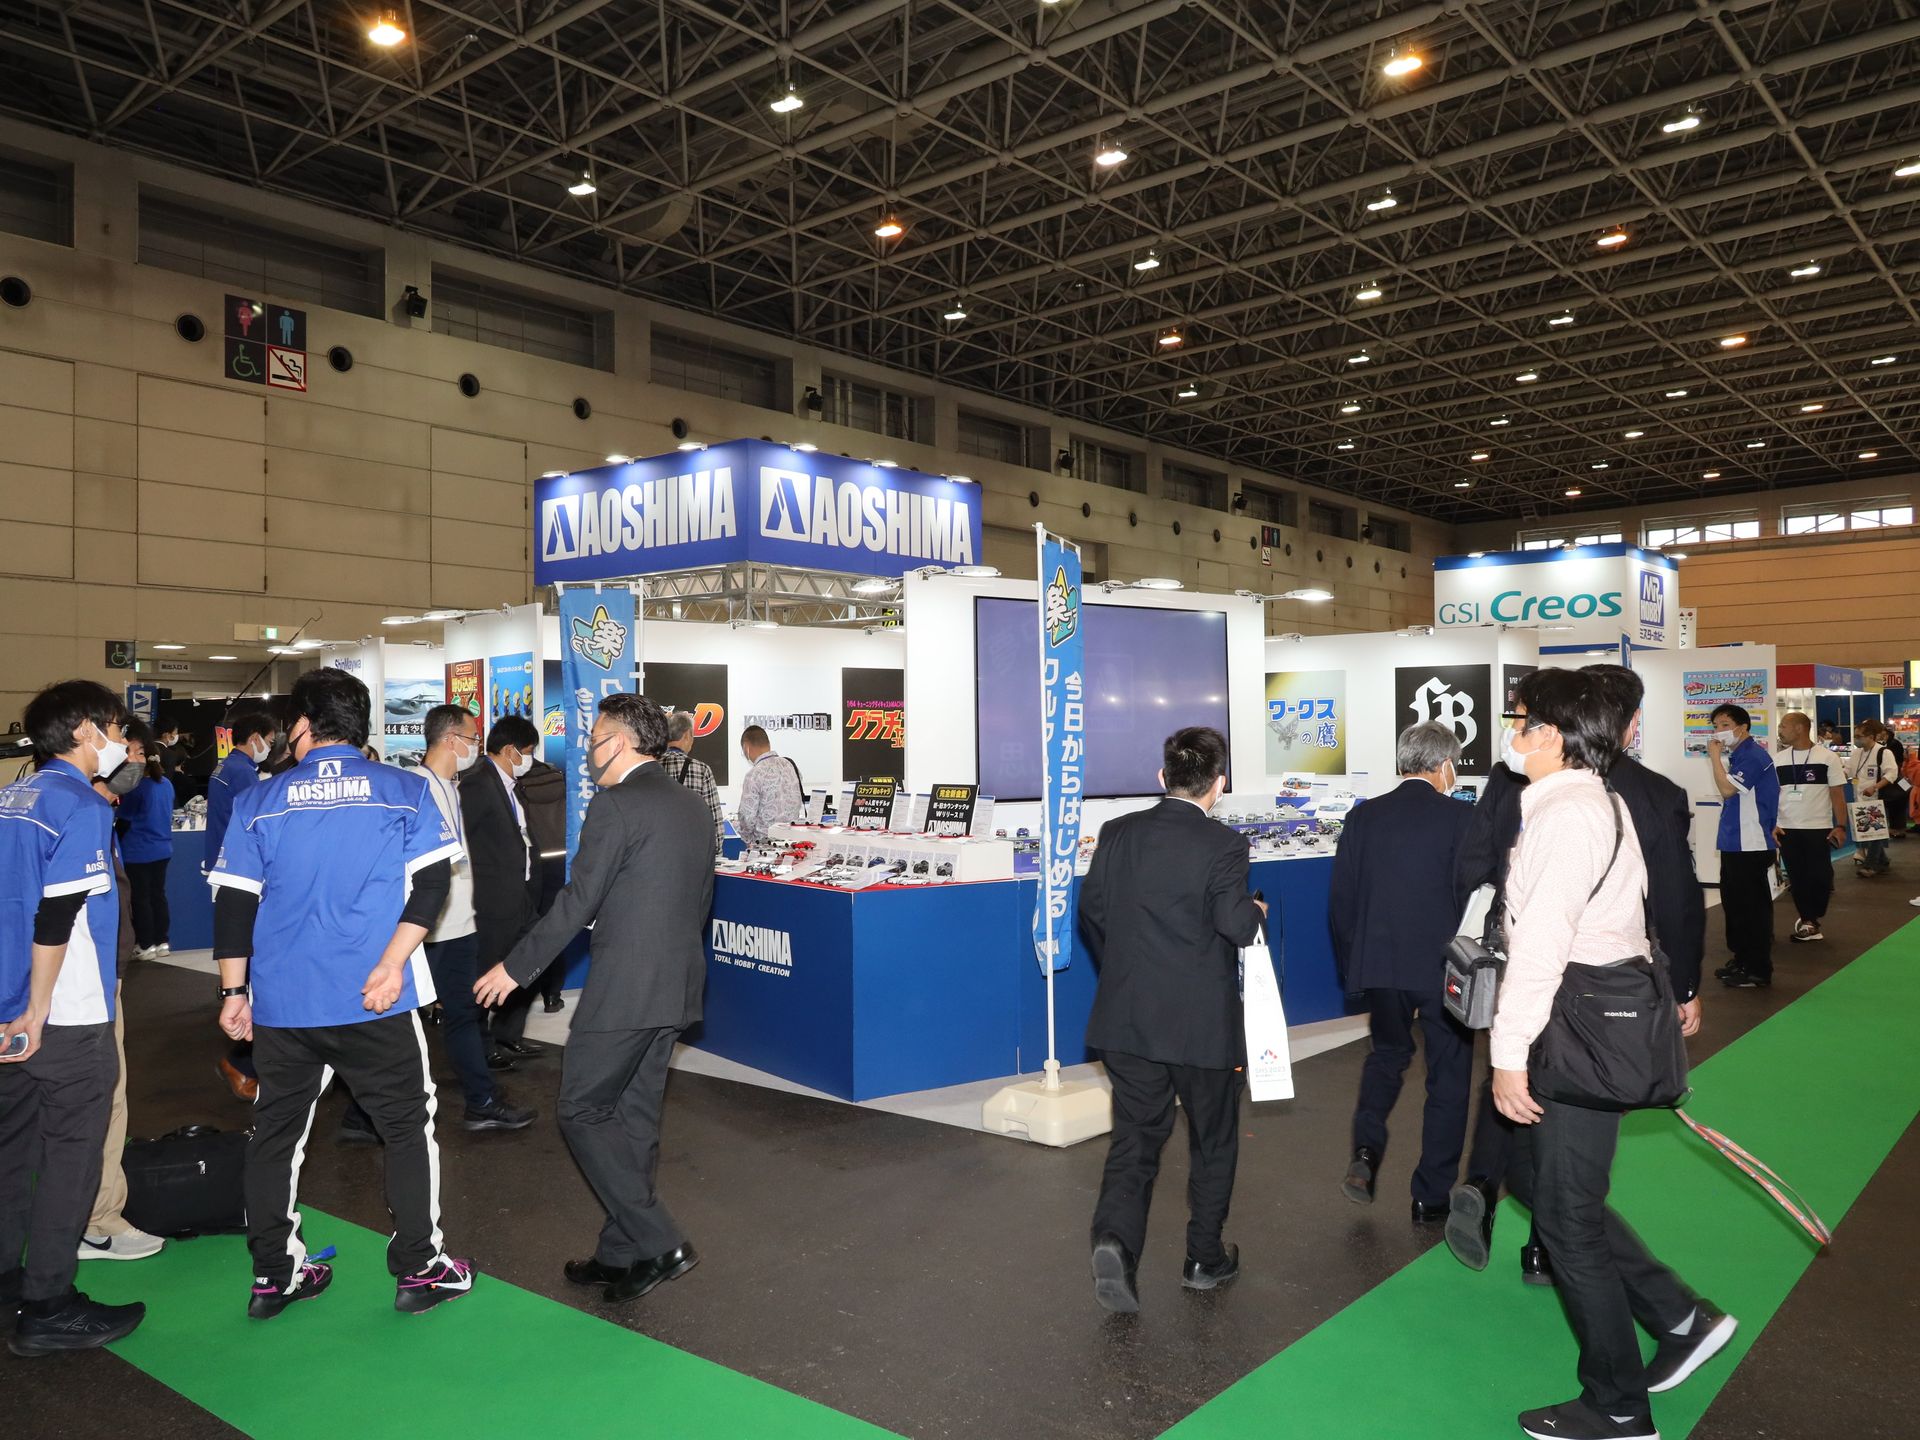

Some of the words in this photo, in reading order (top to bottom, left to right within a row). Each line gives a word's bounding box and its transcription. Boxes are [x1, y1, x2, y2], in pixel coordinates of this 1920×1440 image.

[579, 466, 737, 557] AOSHIMA
[811, 475, 973, 564] AOSHIMA
[1438, 602, 1480, 625] GSI
[1490, 590, 1622, 623] Creos
[1639, 628, 1665, 642] ミスターホビー
[1267, 698, 1337, 722] ワークス
[1301, 721, 1338, 750] の鷹
[287, 780, 372, 803] AOSHIMA
[1050, 671, 1085, 918] 今日からはじめる
[728, 921, 793, 967] AOSHIMA
[714, 953, 732, 965] TOTAL
[734, 958, 756, 970] HOBBY
[757, 964, 791, 978] CREATION
